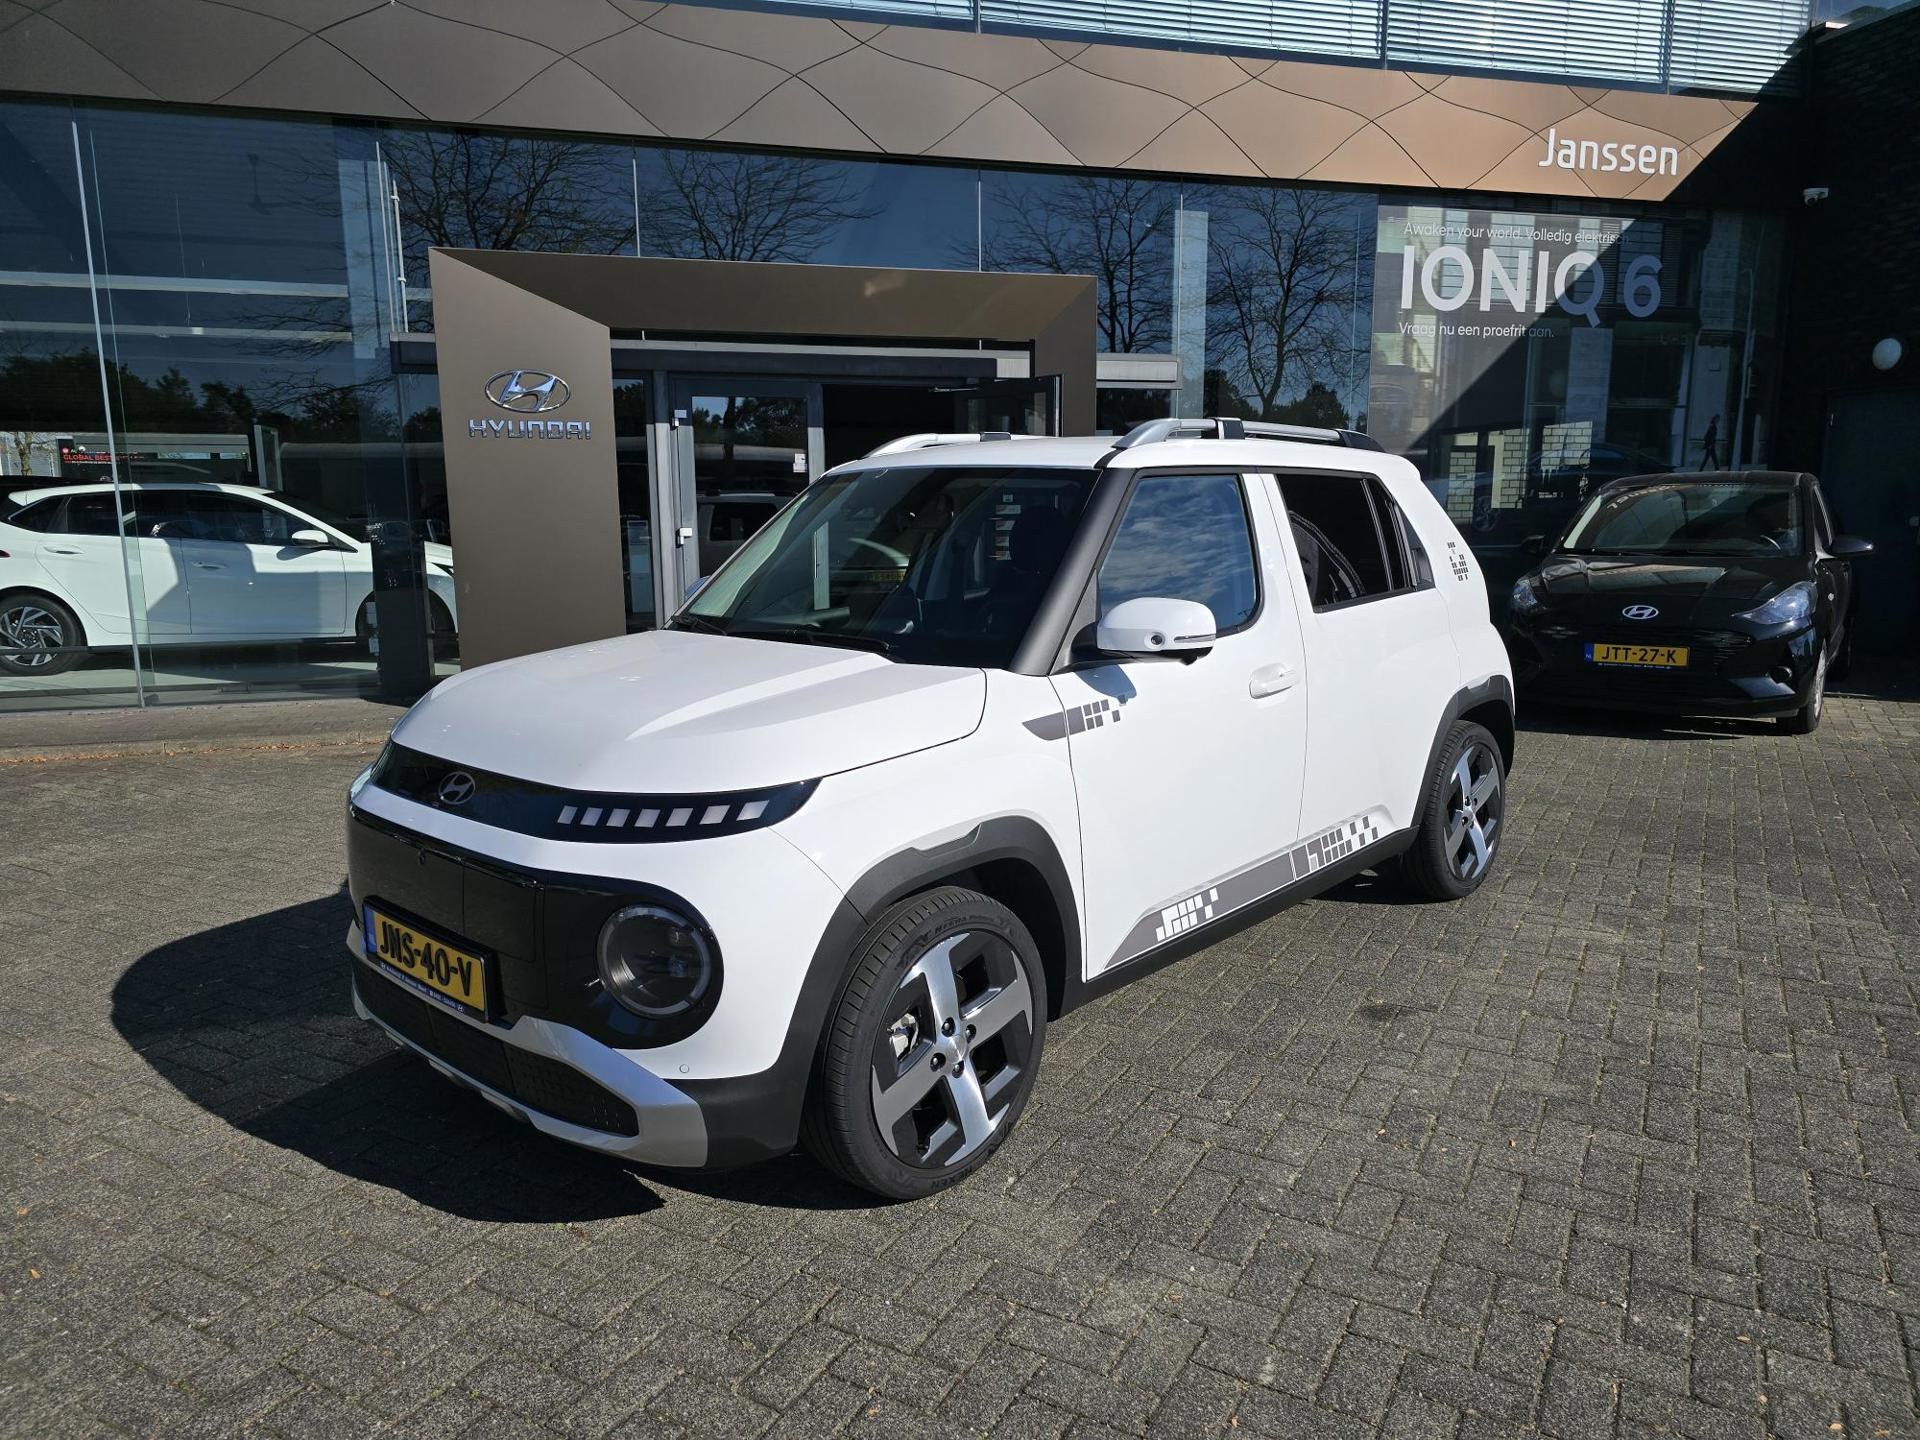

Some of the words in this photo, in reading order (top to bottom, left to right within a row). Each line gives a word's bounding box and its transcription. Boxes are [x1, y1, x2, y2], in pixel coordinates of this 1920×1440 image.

[1538, 128, 1678, 176] Janssen
[1403, 222, 1455, 237] Awaken
[1456, 225, 1484, 241] your
[1487, 225, 1523, 240] world.
[1526, 227, 1572, 244] Volledig
[1400, 245, 1605, 328] IONIQ
[1623, 255, 1664, 318] 6
[1399, 322, 1436, 338] Vraag
[1438, 325, 1455, 336] nu
[1457, 326, 1481, 336] een
[1482, 324, 1526, 338] proefrit
[468, 418, 593, 440] HYUNDAI
[1602, 646, 1677, 664] JTT-27-K
[380, 920, 472, 996] JNS-40-V
